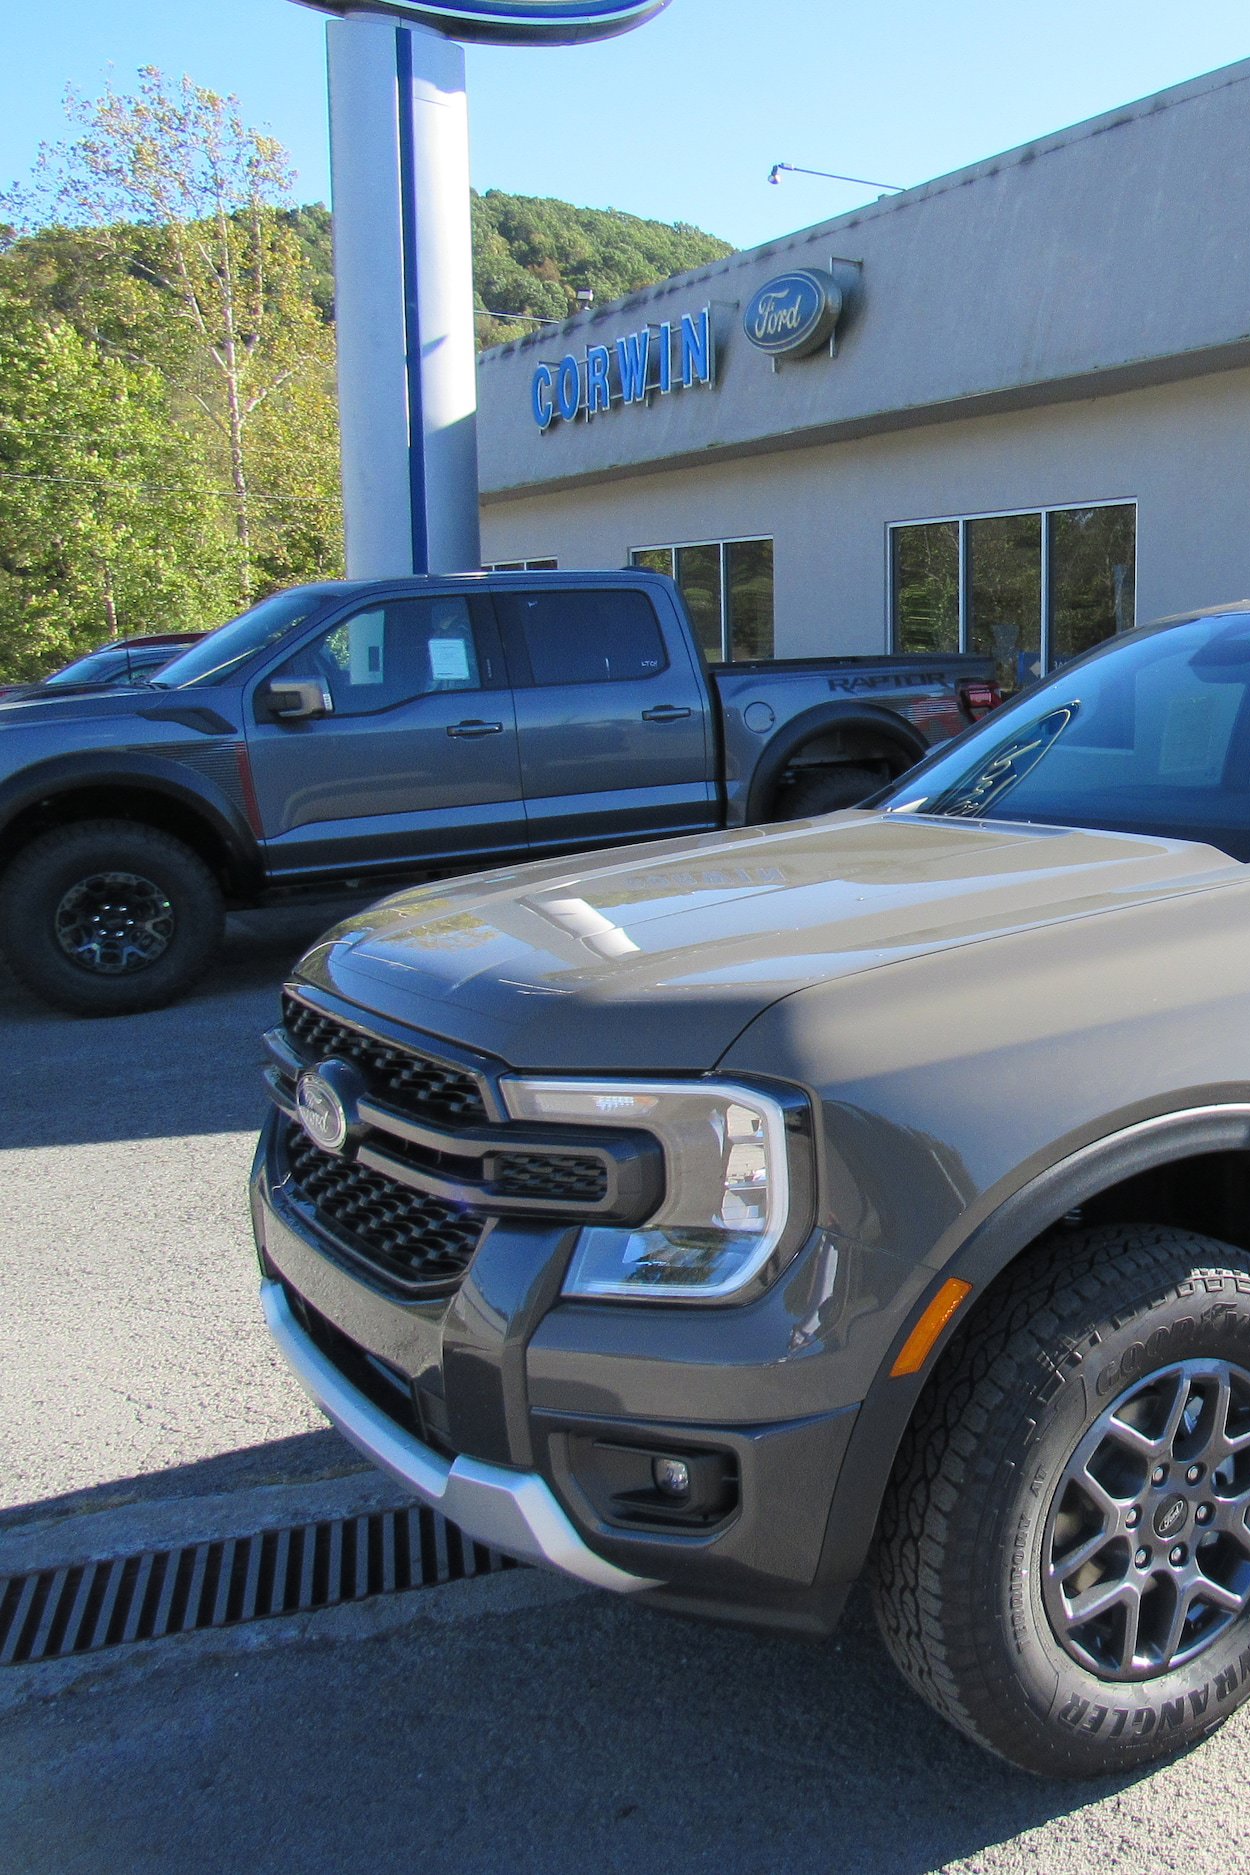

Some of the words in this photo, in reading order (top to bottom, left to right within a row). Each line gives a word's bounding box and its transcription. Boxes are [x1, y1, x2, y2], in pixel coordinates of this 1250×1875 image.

[754, 288, 802, 338] Ford
[531, 307, 710, 430] CORWIN
[827, 673, 953, 695] RAPTOR
